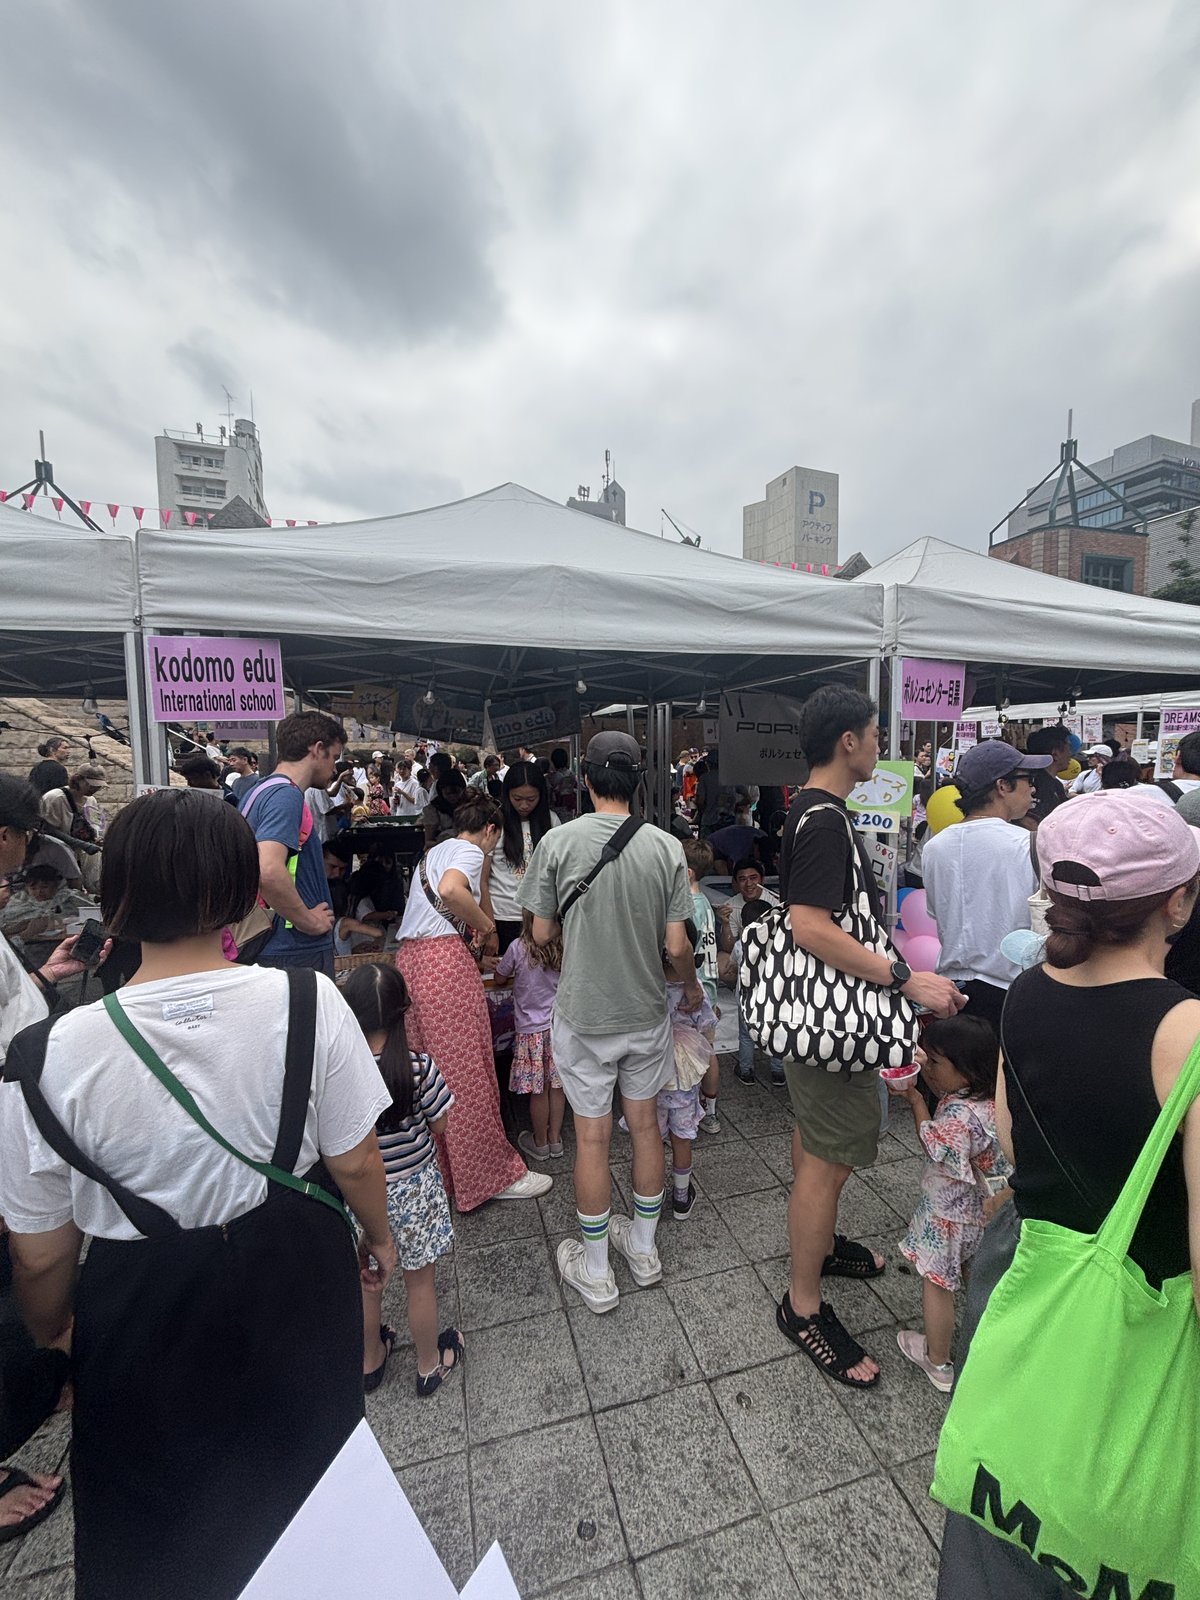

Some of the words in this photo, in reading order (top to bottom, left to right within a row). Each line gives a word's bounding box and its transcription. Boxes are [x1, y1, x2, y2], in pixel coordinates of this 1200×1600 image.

[809, 491, 825, 515] P
[154, 646, 235, 683] kodomo
[243, 649, 277, 683] edu
[159, 688, 237, 712] International
[239, 688, 277, 711] school
[759, 746, 806, 760] ポルシェセ
